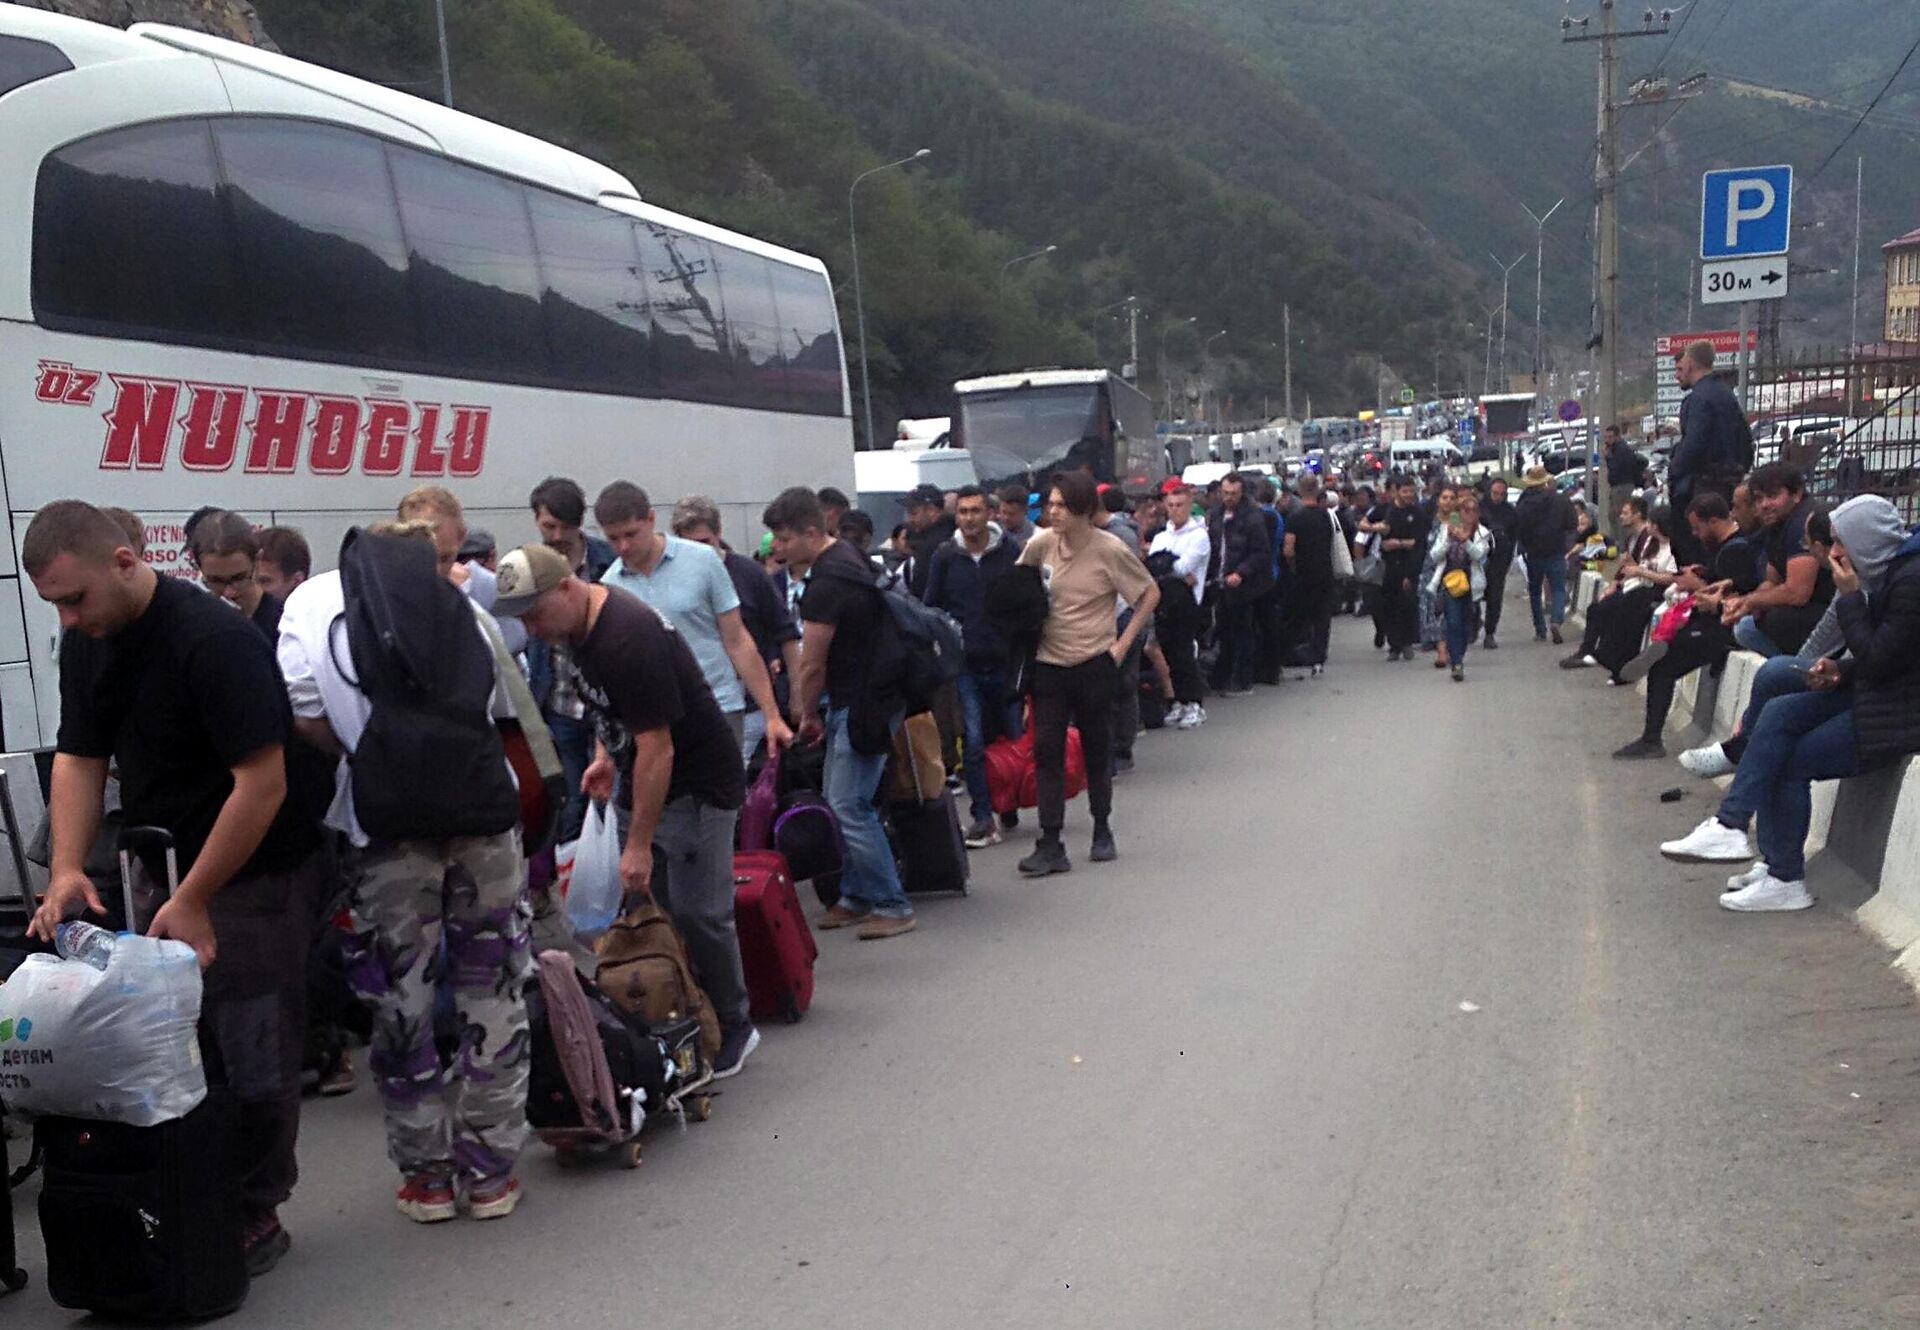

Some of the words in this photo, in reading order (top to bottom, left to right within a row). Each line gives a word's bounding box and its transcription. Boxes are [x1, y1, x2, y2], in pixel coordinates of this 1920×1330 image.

[1726, 179, 1775, 246] P
[36, 359, 102, 406] ÖZ
[2, 1048, 54, 1068] детям
